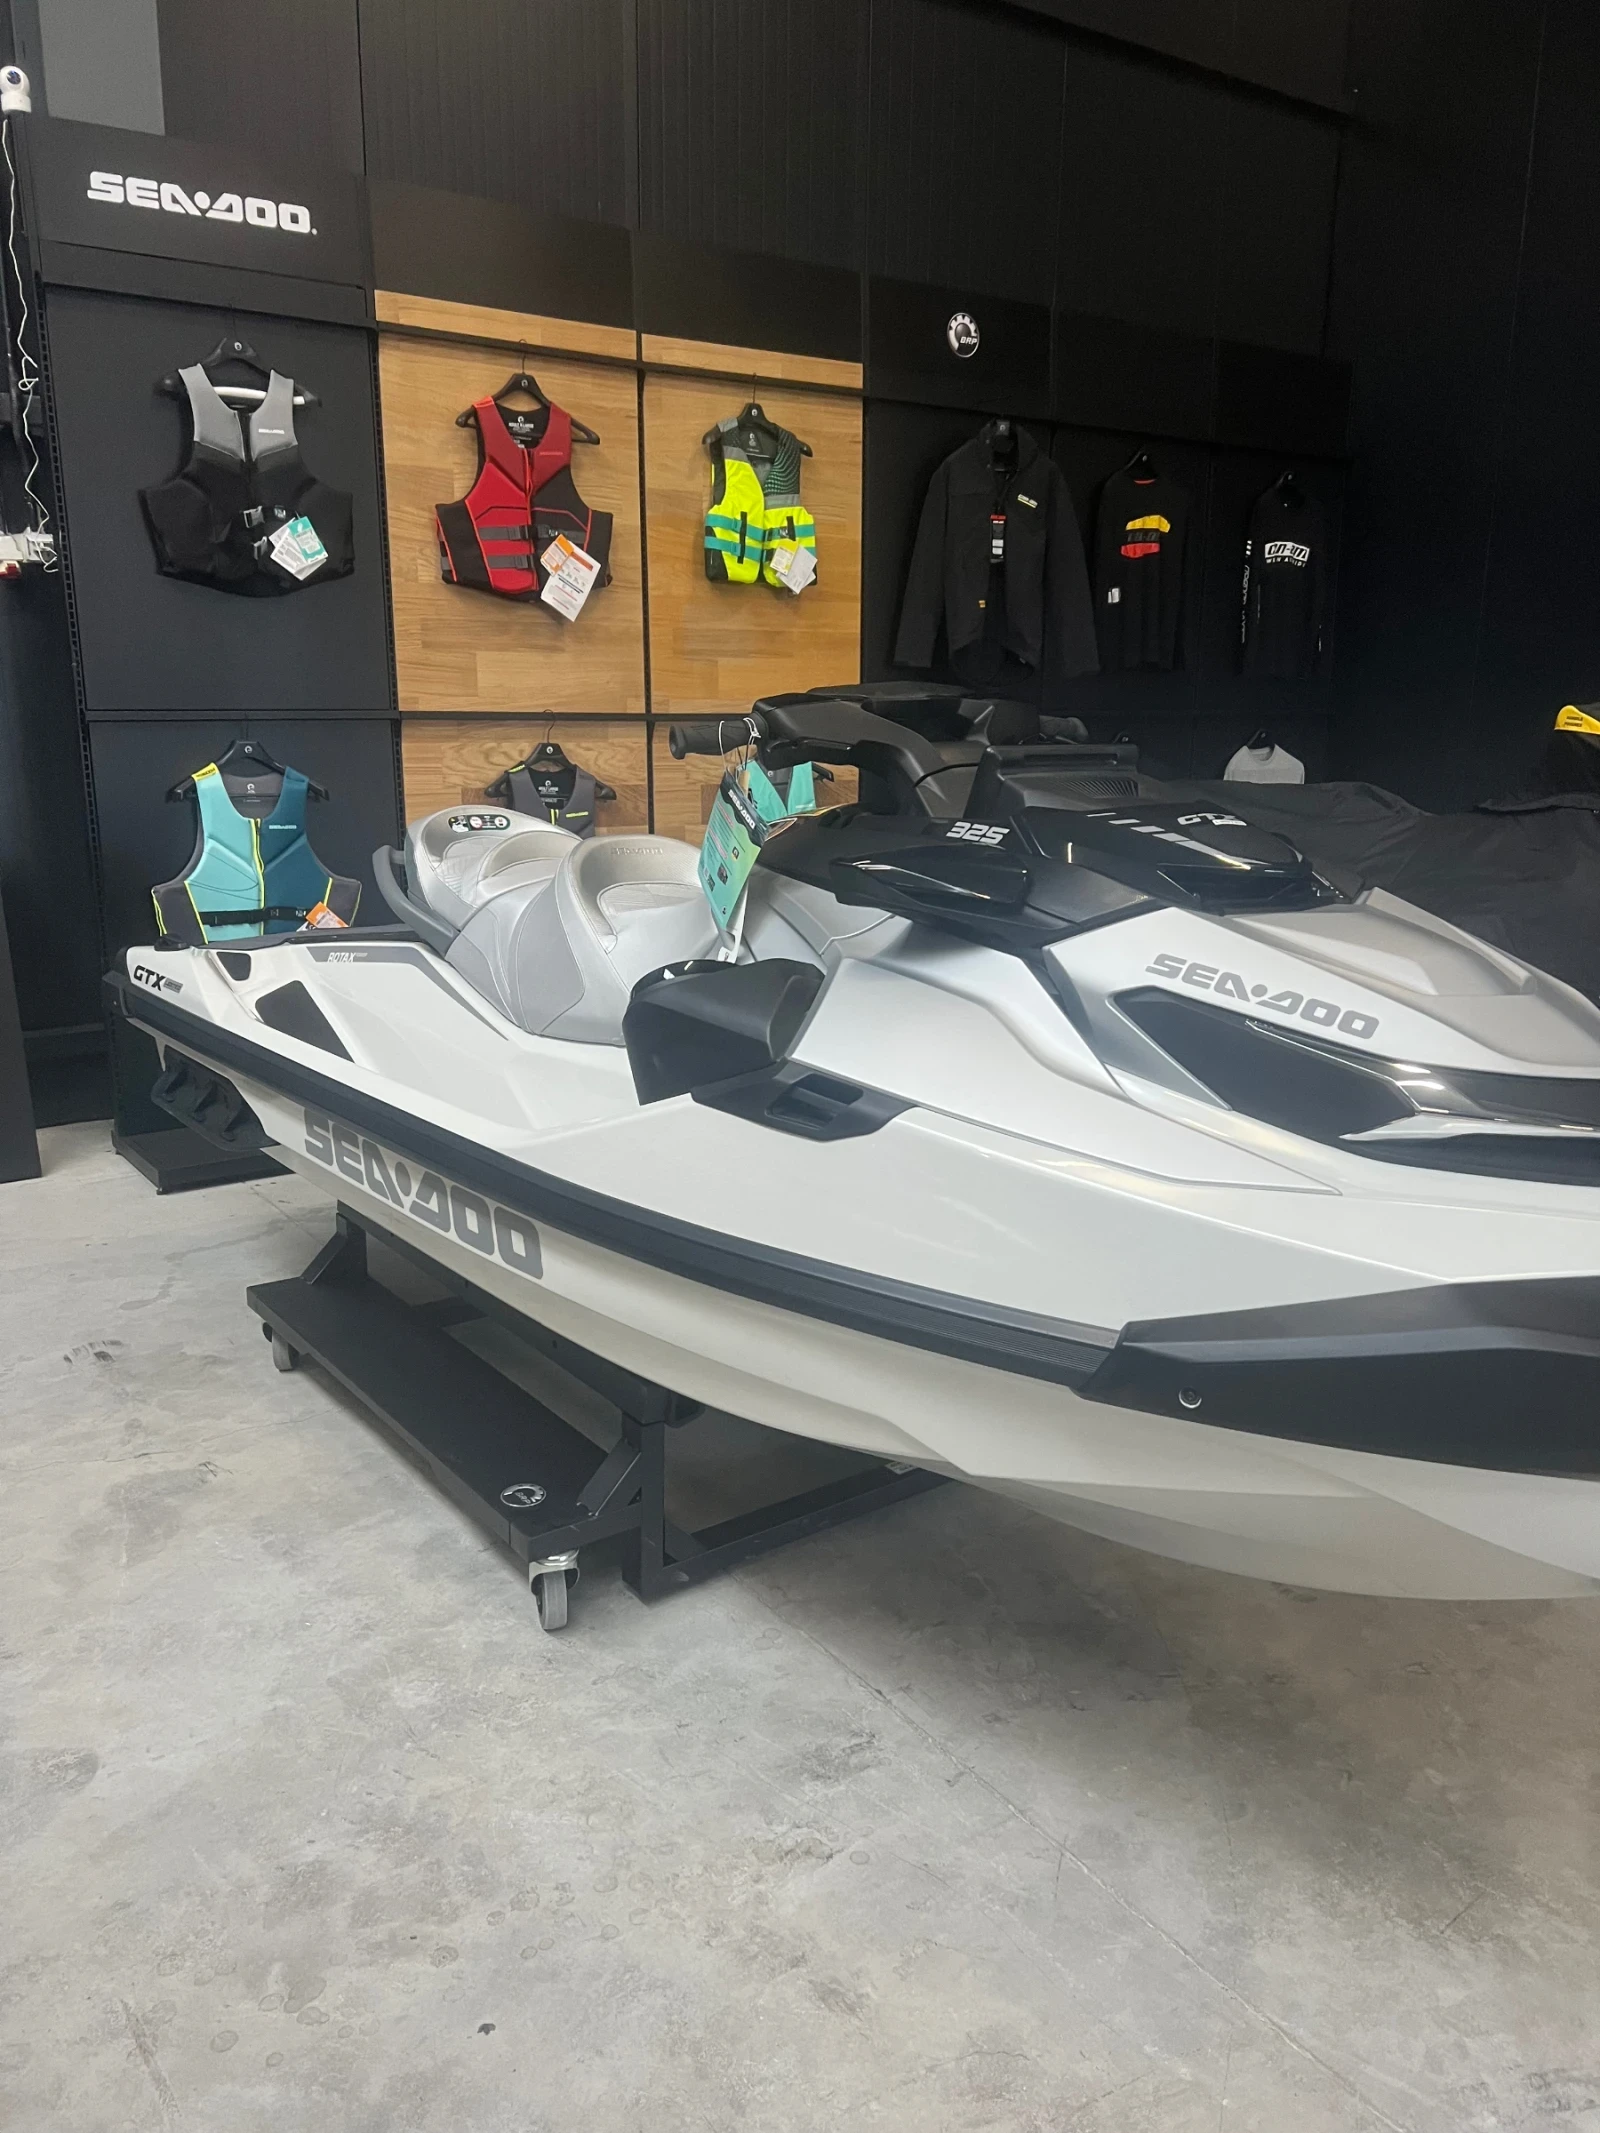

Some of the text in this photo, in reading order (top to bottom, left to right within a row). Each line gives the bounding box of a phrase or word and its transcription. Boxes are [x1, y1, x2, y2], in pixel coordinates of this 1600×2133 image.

[960, 336, 978, 345] BRP
[946, 821, 1010, 845] 325
[327, 952, 356, 963] ROTAX
[133, 965, 166, 992] GTX
